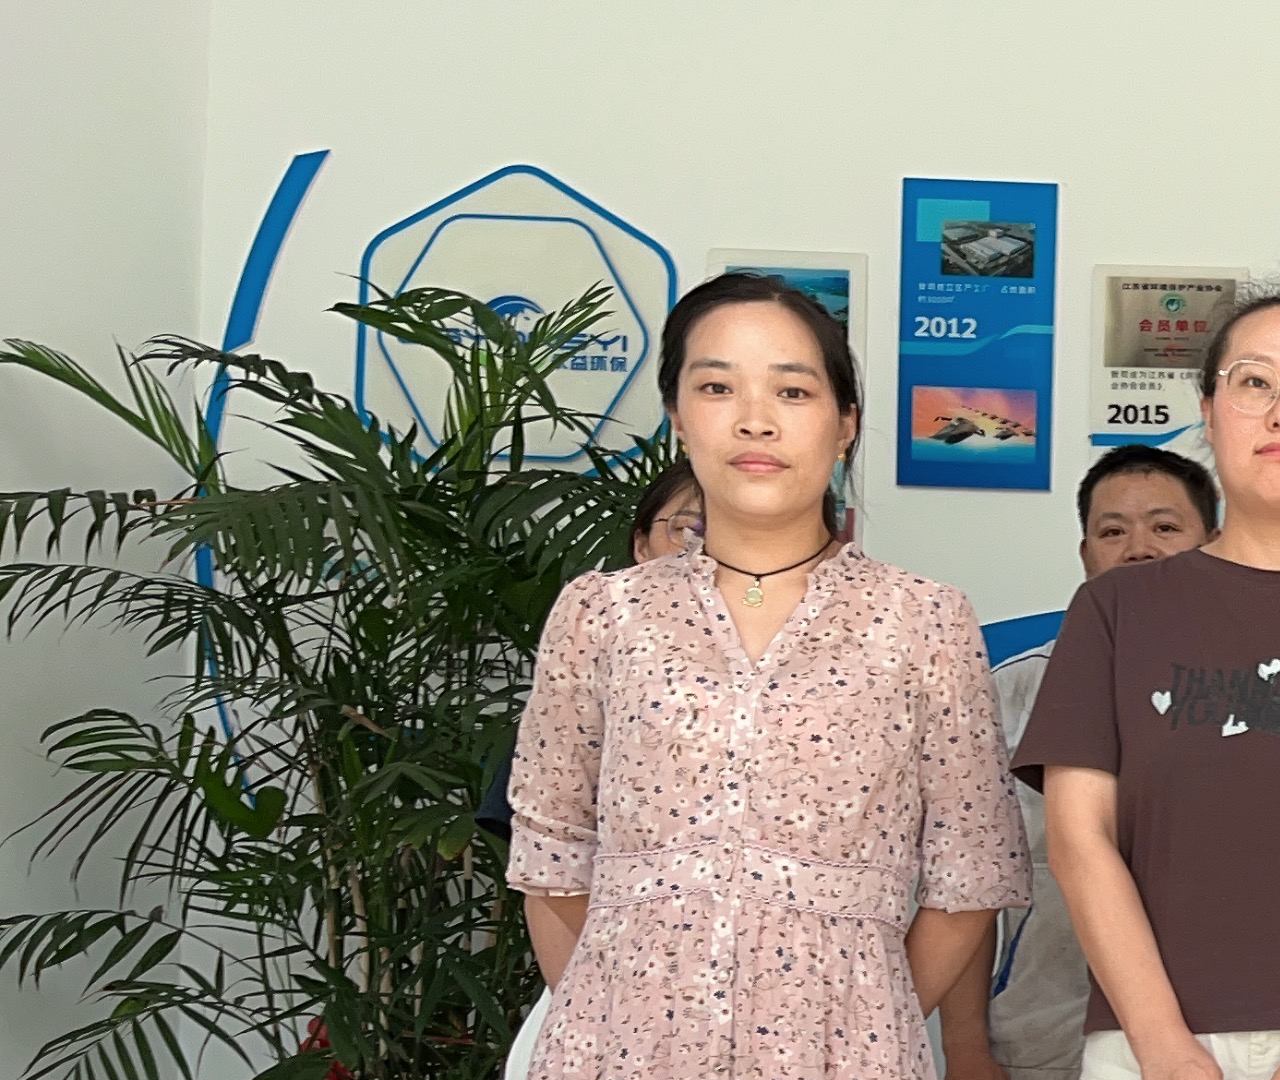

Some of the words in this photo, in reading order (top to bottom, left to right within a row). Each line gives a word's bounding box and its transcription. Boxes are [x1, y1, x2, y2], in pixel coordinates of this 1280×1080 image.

[914, 316, 977, 338] 2012
[1139, 319, 1209, 334] 会员单位
[1107, 404, 1170, 425] 2015
